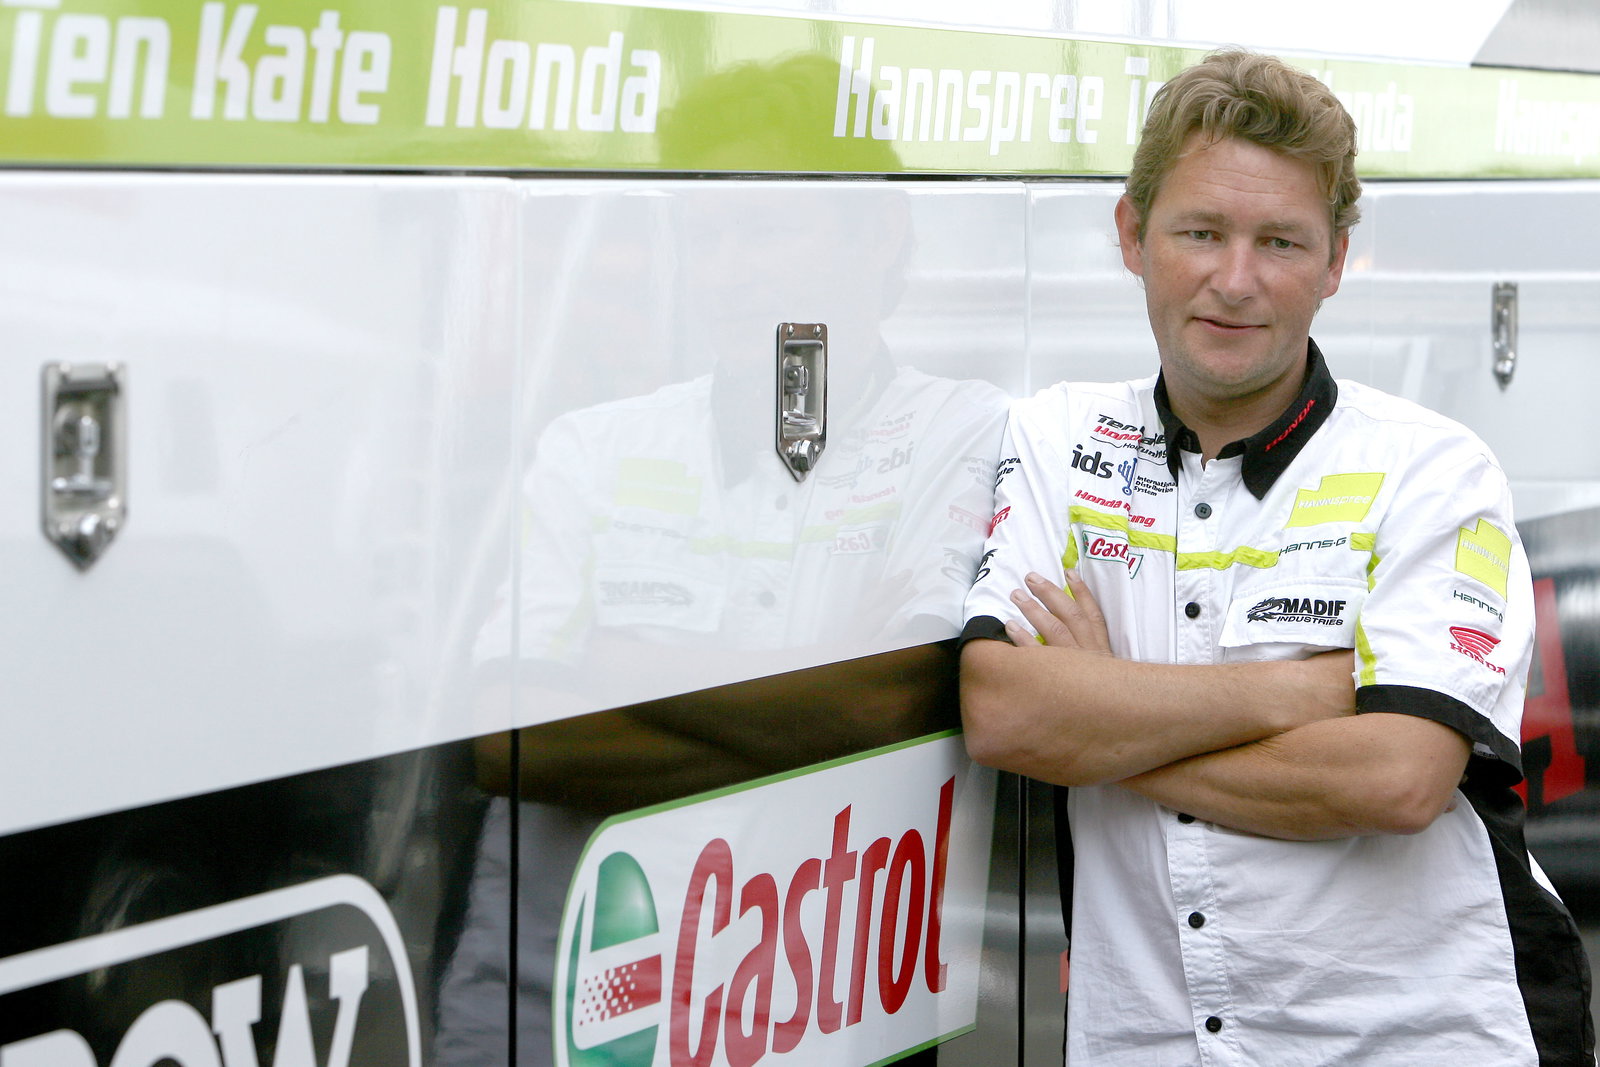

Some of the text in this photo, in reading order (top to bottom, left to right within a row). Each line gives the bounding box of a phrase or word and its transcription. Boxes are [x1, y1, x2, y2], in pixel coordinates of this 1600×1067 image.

[3, 0, 662, 134] Ten Kate Honda
[833, 36, 1104, 156] Hannspree
[1322, 70, 1415, 152] nda
[1093, 424, 1143, 444] Hond
[1098, 413, 1138, 433] Ten
[1071, 443, 1115, 479] ids
[1075, 489, 1123, 509] Honda
[1133, 485, 1158, 497] System
[1276, 615, 1344, 626] INDUSTRIES
[1283, 598, 1346, 616] MADIF
[1449, 641, 1506, 677] HONDA
[669, 774, 956, 1067] Castrol
